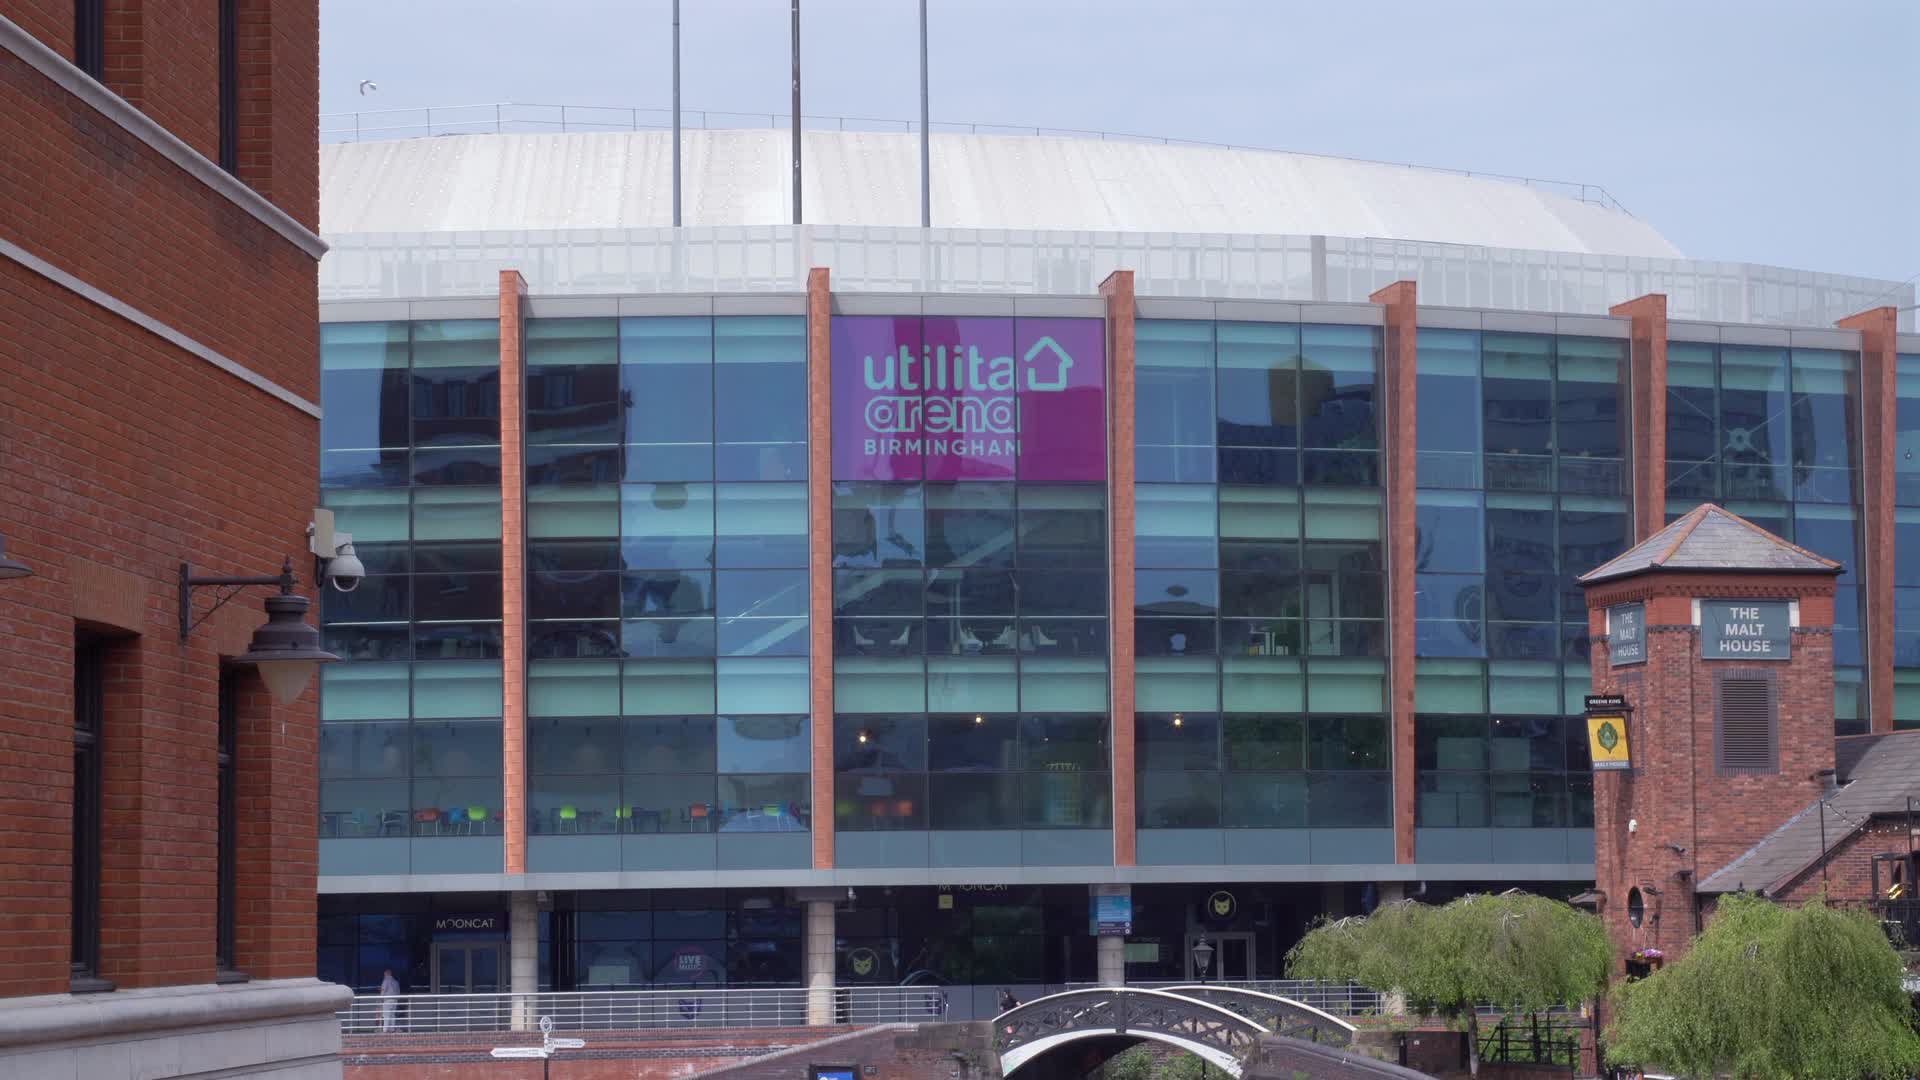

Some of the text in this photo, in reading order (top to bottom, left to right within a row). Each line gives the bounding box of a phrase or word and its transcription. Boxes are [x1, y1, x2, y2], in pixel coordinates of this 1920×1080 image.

[864, 345, 1019, 390] utilita
[864, 395, 1020, 433] arena
[864, 439, 1021, 456] BIRMINGHAM
[1621, 611, 1633, 625] THE
[1730, 607, 1759, 620] THE
[1619, 627, 1635, 641] MALT
[1725, 623, 1765, 636] MALT
[1617, 643, 1639, 657] HOUSE
[1720, 640, 1771, 652] HOUSE
[436, 918, 495, 929] MOONCAT
[679, 955, 701, 965] LIVE
